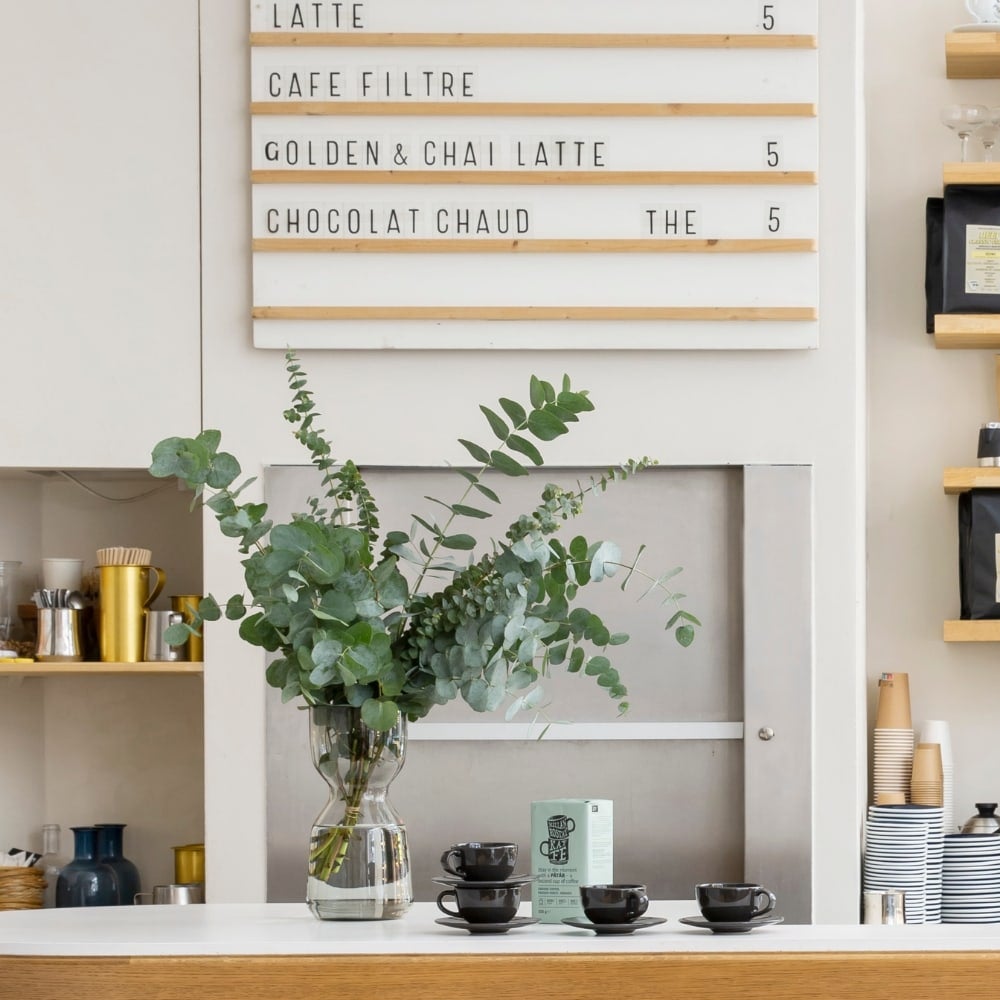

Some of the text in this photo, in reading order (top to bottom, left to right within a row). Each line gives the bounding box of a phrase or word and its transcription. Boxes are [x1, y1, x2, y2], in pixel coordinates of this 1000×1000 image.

[273, 2, 776, 31] LATTE 5
[269, 71, 475, 98] CAFE FILTRE
[264, 140, 780, 168] GOLDEN & CHAI LATTE 5
[267, 206, 781, 236] CHOCOLAT CHAUD THE 5
